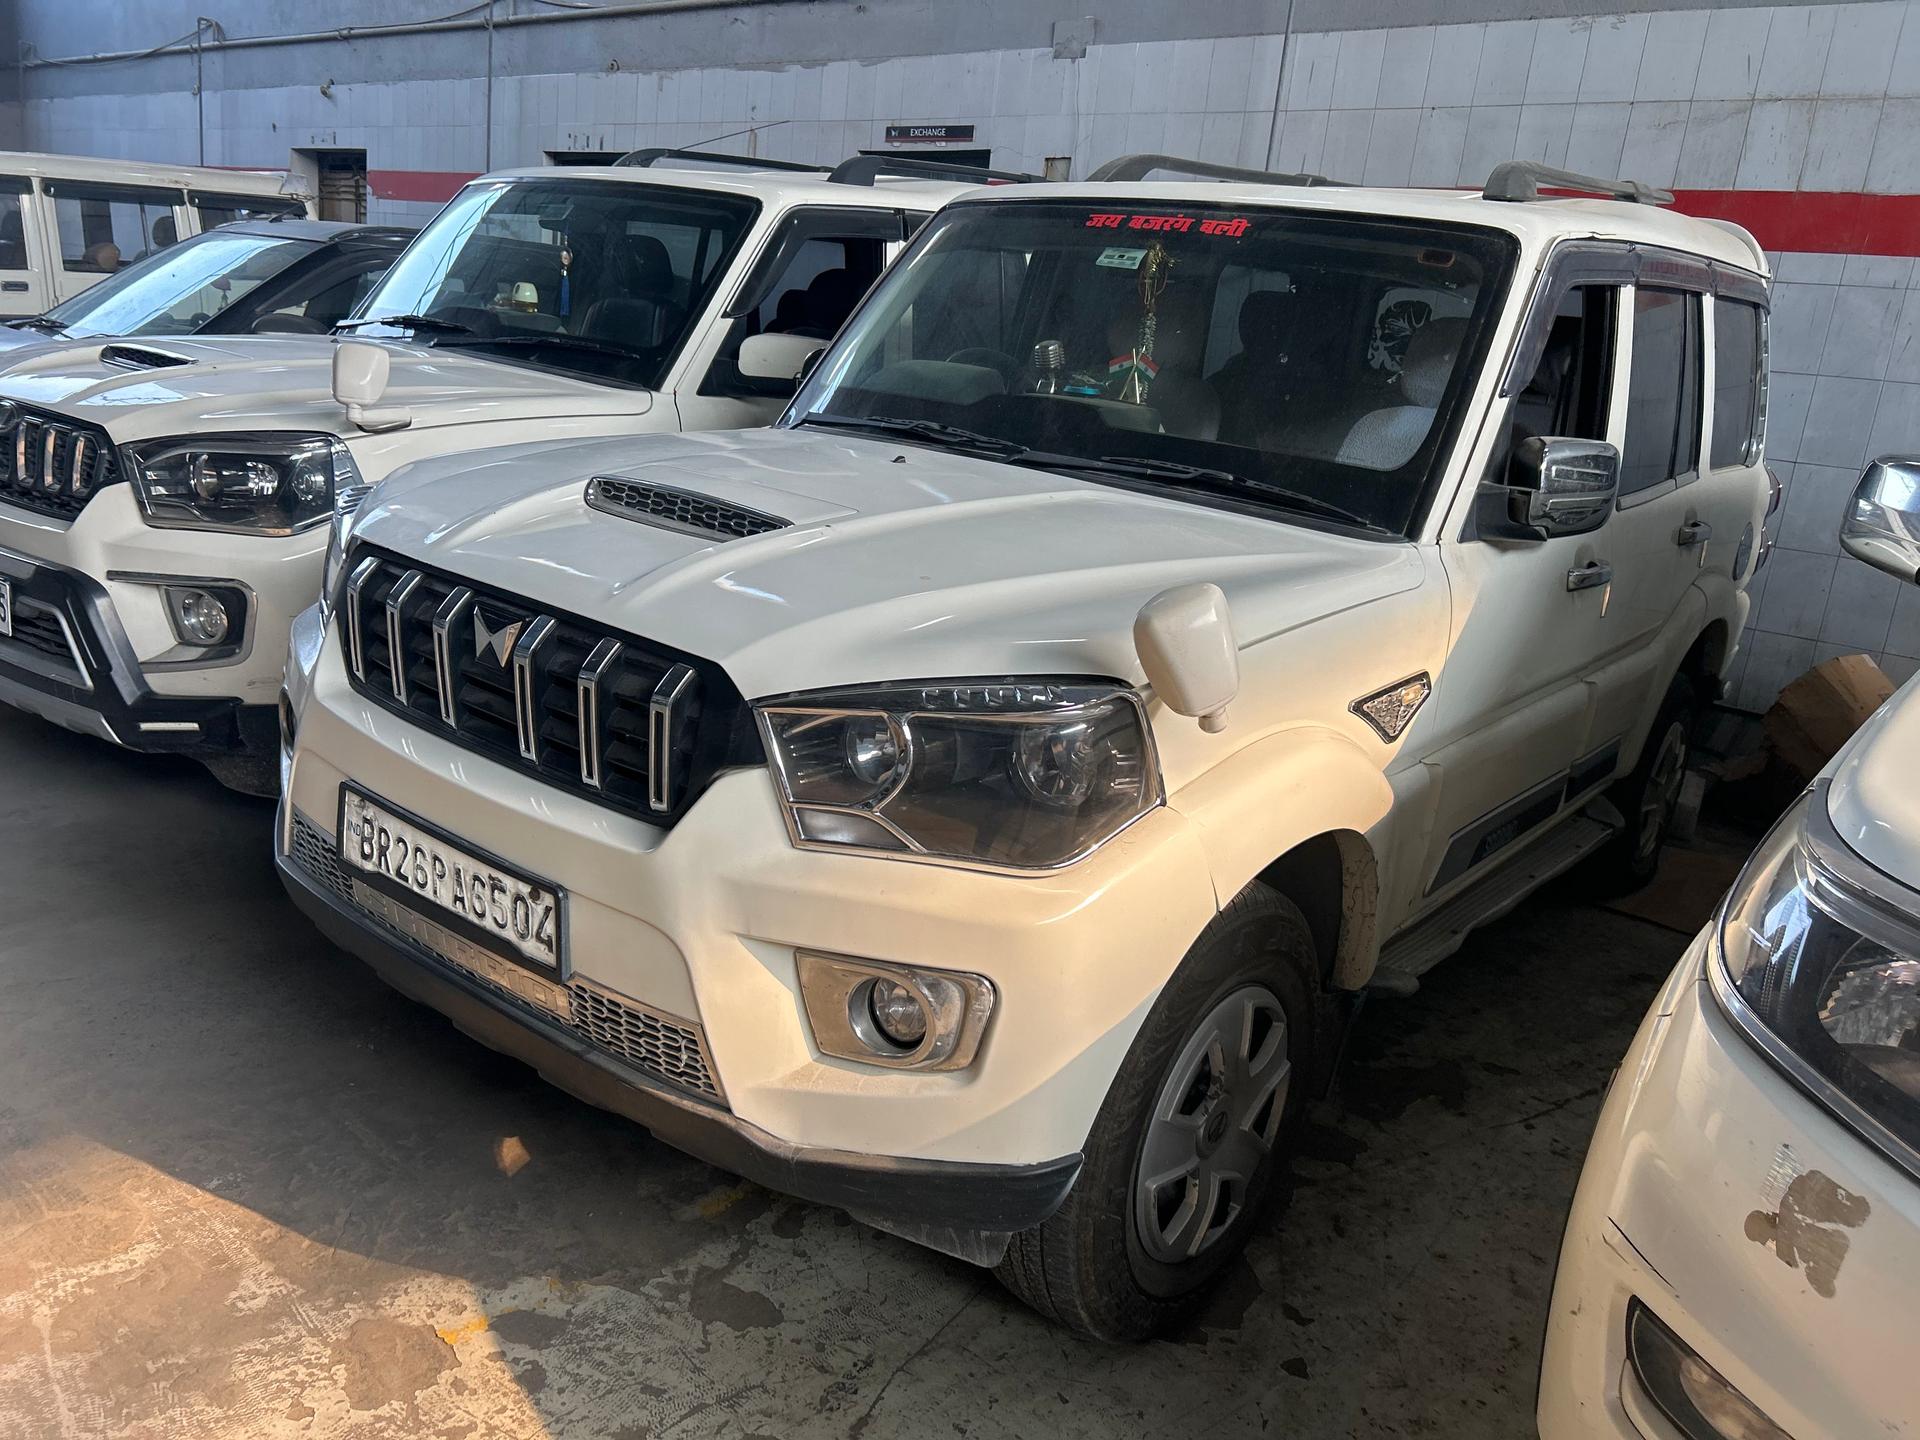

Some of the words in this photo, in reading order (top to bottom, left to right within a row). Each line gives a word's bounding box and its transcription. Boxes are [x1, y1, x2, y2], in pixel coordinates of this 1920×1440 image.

[910, 128, 946, 136] EXCHANGE
[1086, 214, 1127, 228] जय
[1128, 214, 1196, 232] बजरंग
[1199, 217, 1252, 238] बली
[360, 815, 554, 953] BR26PA6504
